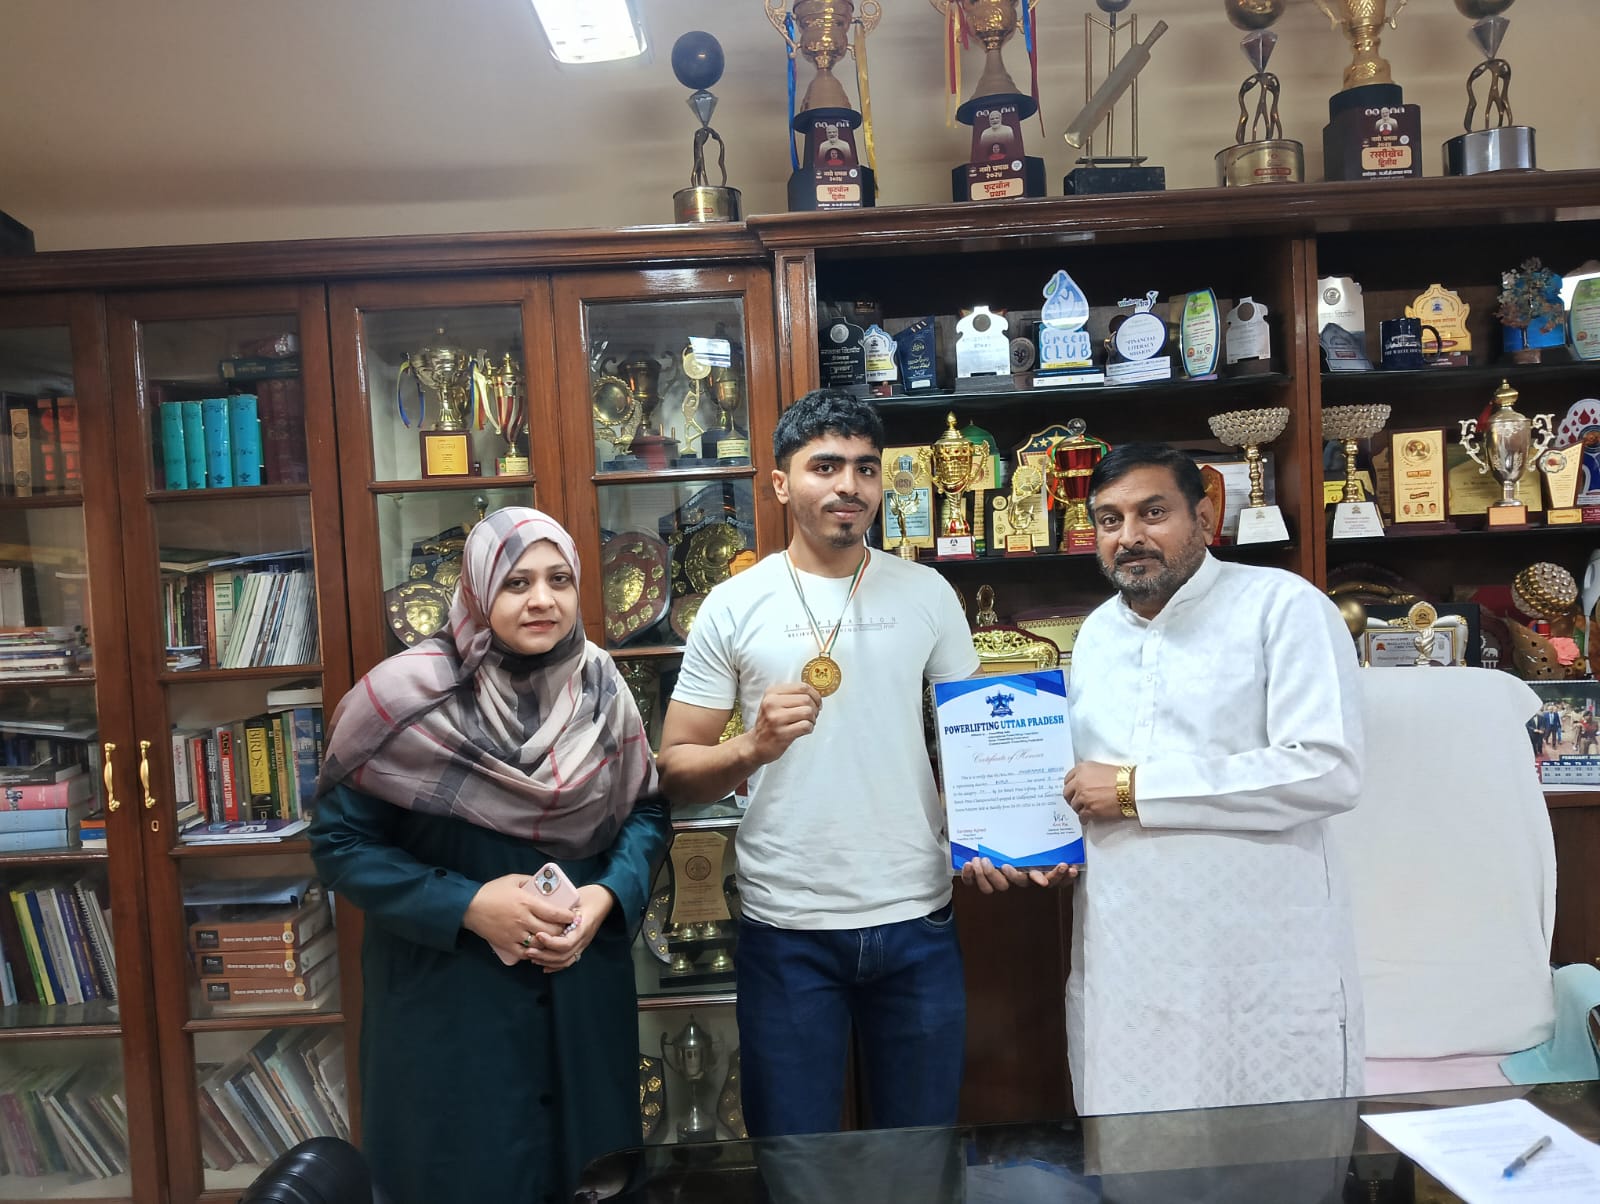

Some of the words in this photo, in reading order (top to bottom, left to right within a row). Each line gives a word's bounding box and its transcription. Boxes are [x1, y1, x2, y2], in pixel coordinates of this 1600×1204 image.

[1043, 332, 1087, 345] Green
[1044, 343, 1089, 360] CLUB
[944, 721, 1000, 735] POWERLIFTING
[1000, 719, 1026, 729] UTTAR
[1027, 715, 1064, 727] PRADESH
[249, 729, 262, 767] BIRDS
